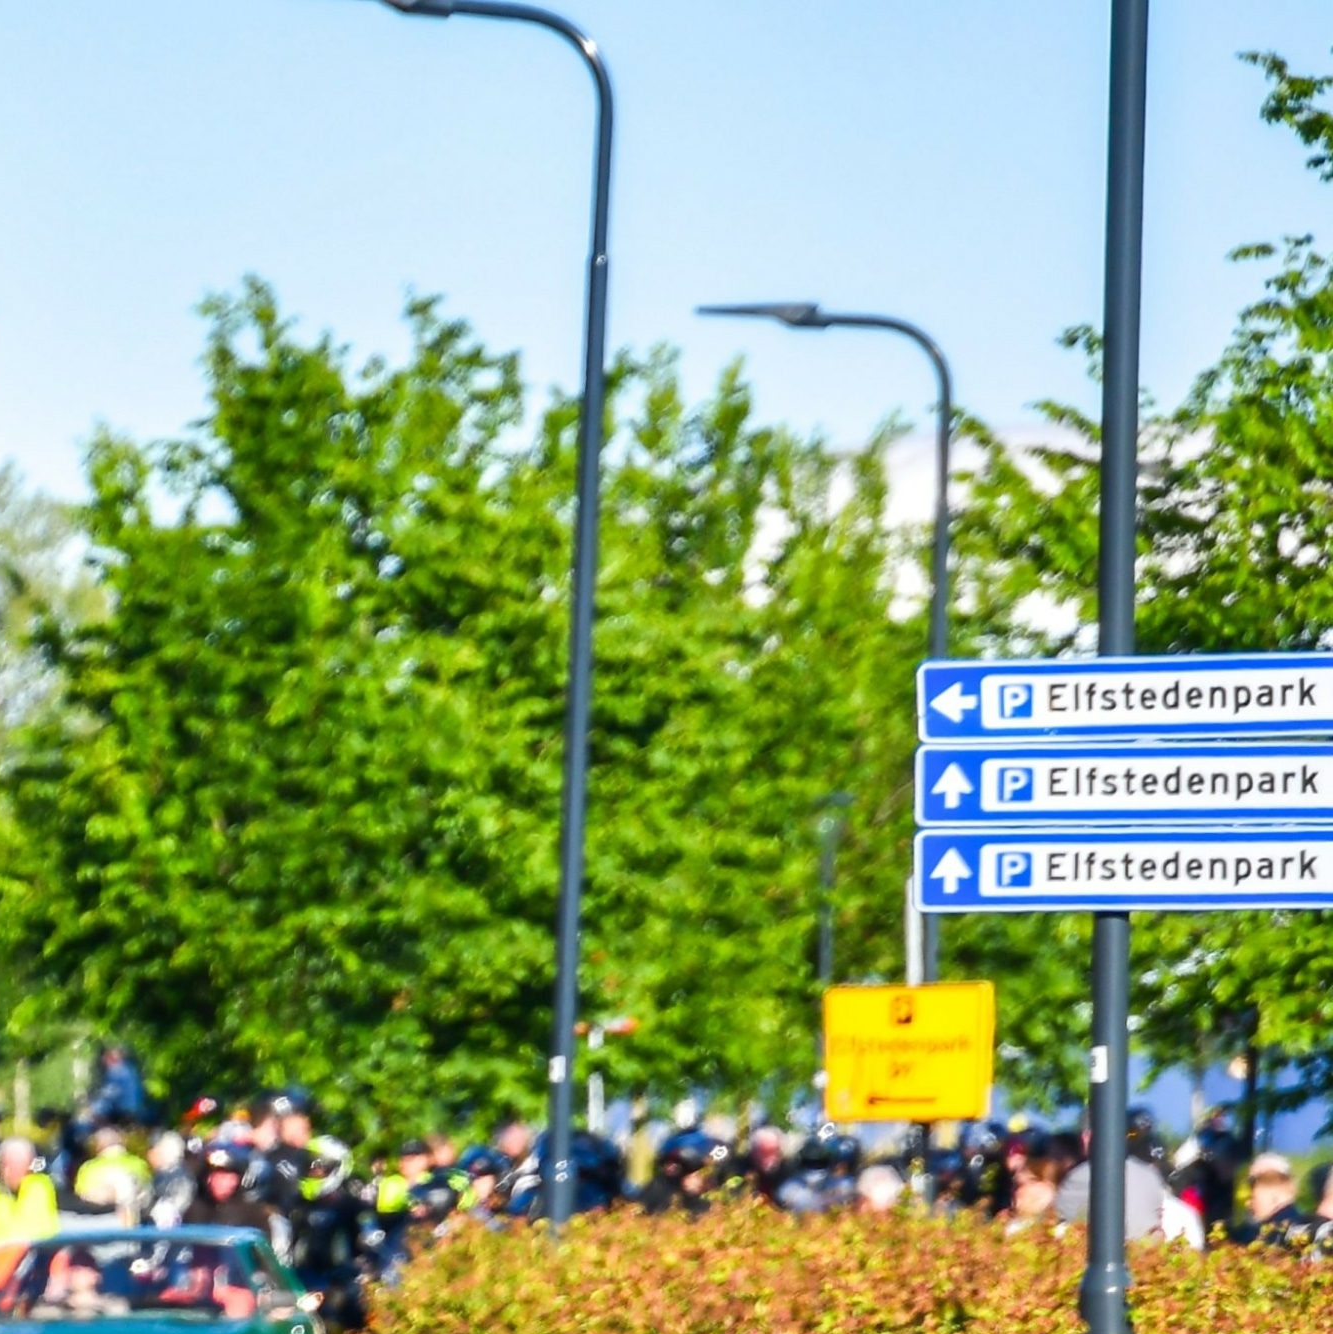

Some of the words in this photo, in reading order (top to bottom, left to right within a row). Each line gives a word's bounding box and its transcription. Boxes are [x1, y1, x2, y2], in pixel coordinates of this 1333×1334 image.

[1047, 676, 1317, 715] Elfstedenpark
[1047, 764, 1319, 801] Elfstedenpark
[1045, 850, 1318, 887] Elfstedenpark
